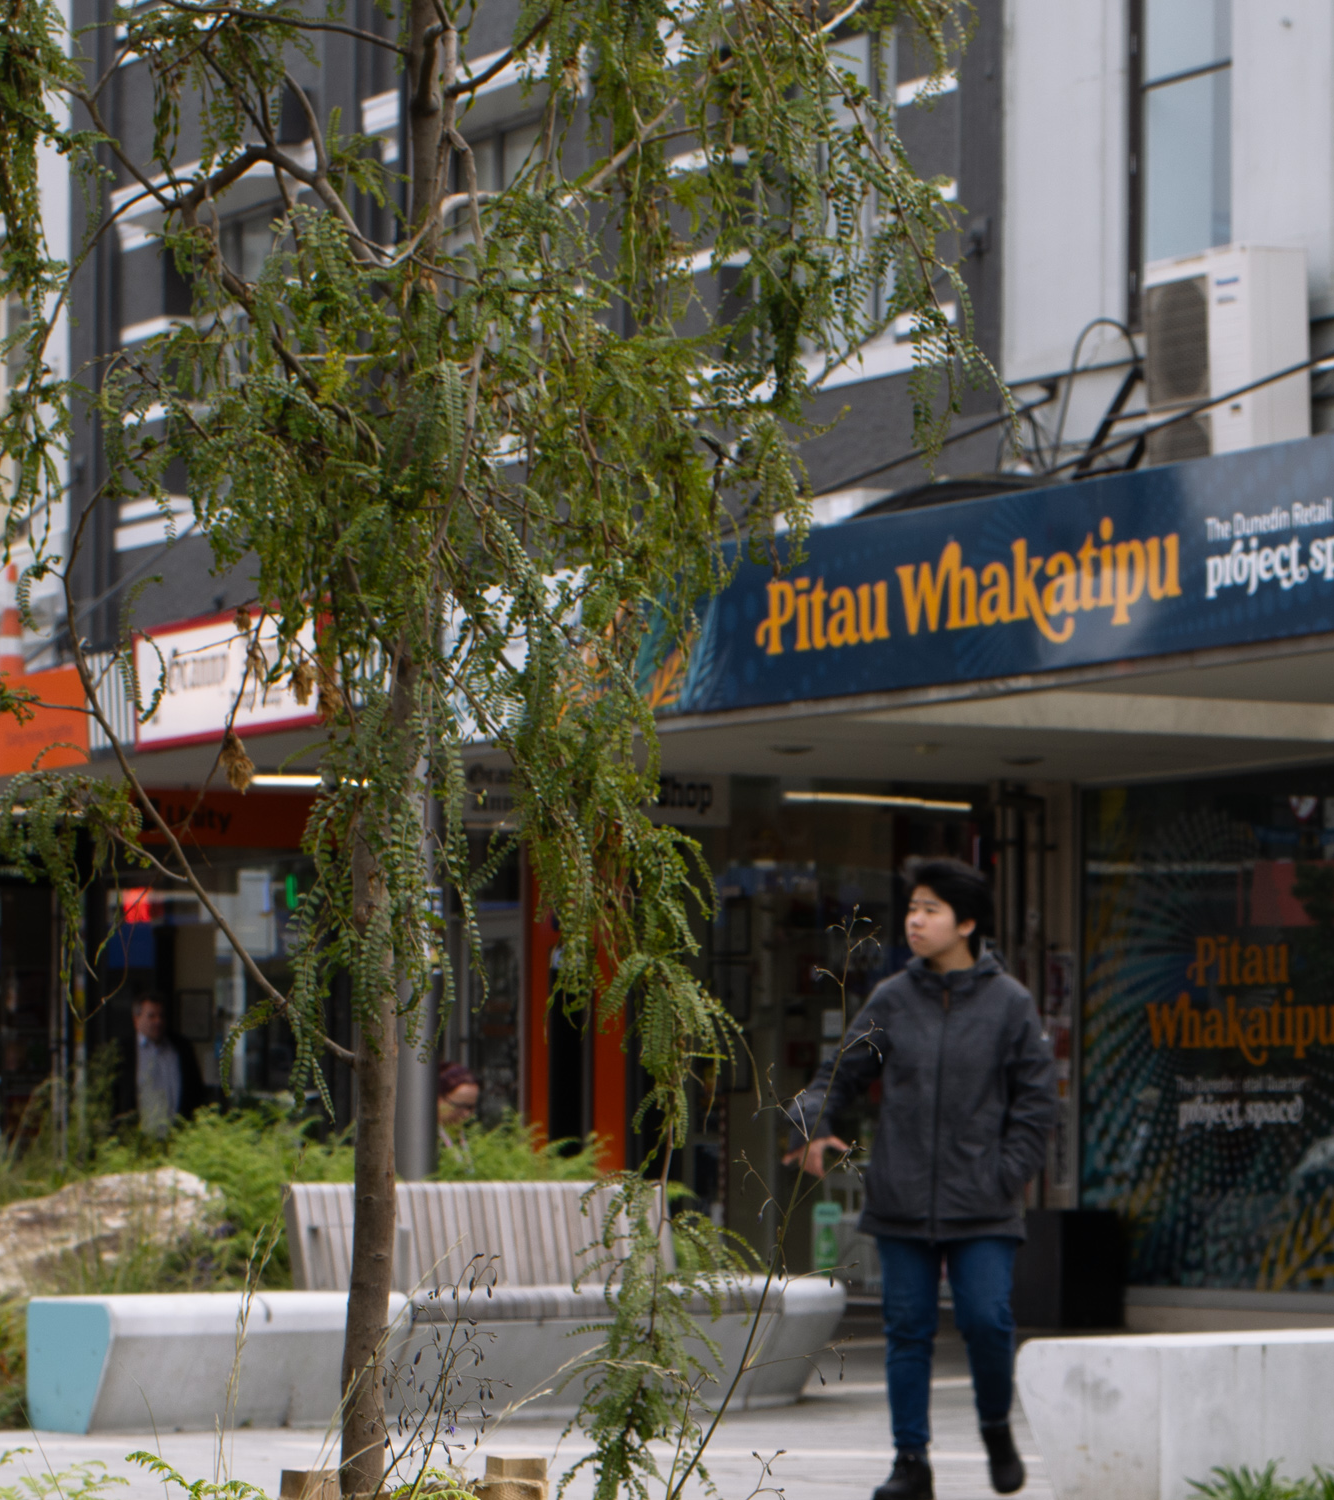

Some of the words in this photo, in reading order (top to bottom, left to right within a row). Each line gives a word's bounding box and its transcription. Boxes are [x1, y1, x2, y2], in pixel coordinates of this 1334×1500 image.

[1205, 515, 1233, 543] The
[1232, 505, 1291, 539] Dunedin
[1291, 496, 1334, 528] Retail
[755, 576, 891, 656] Pitau
[895, 516, 1183, 645] Whakatipu
[1205, 535, 1310, 600] project
[1185, 934, 1291, 988] Pitau
[1244, 1093, 1305, 1130] space
